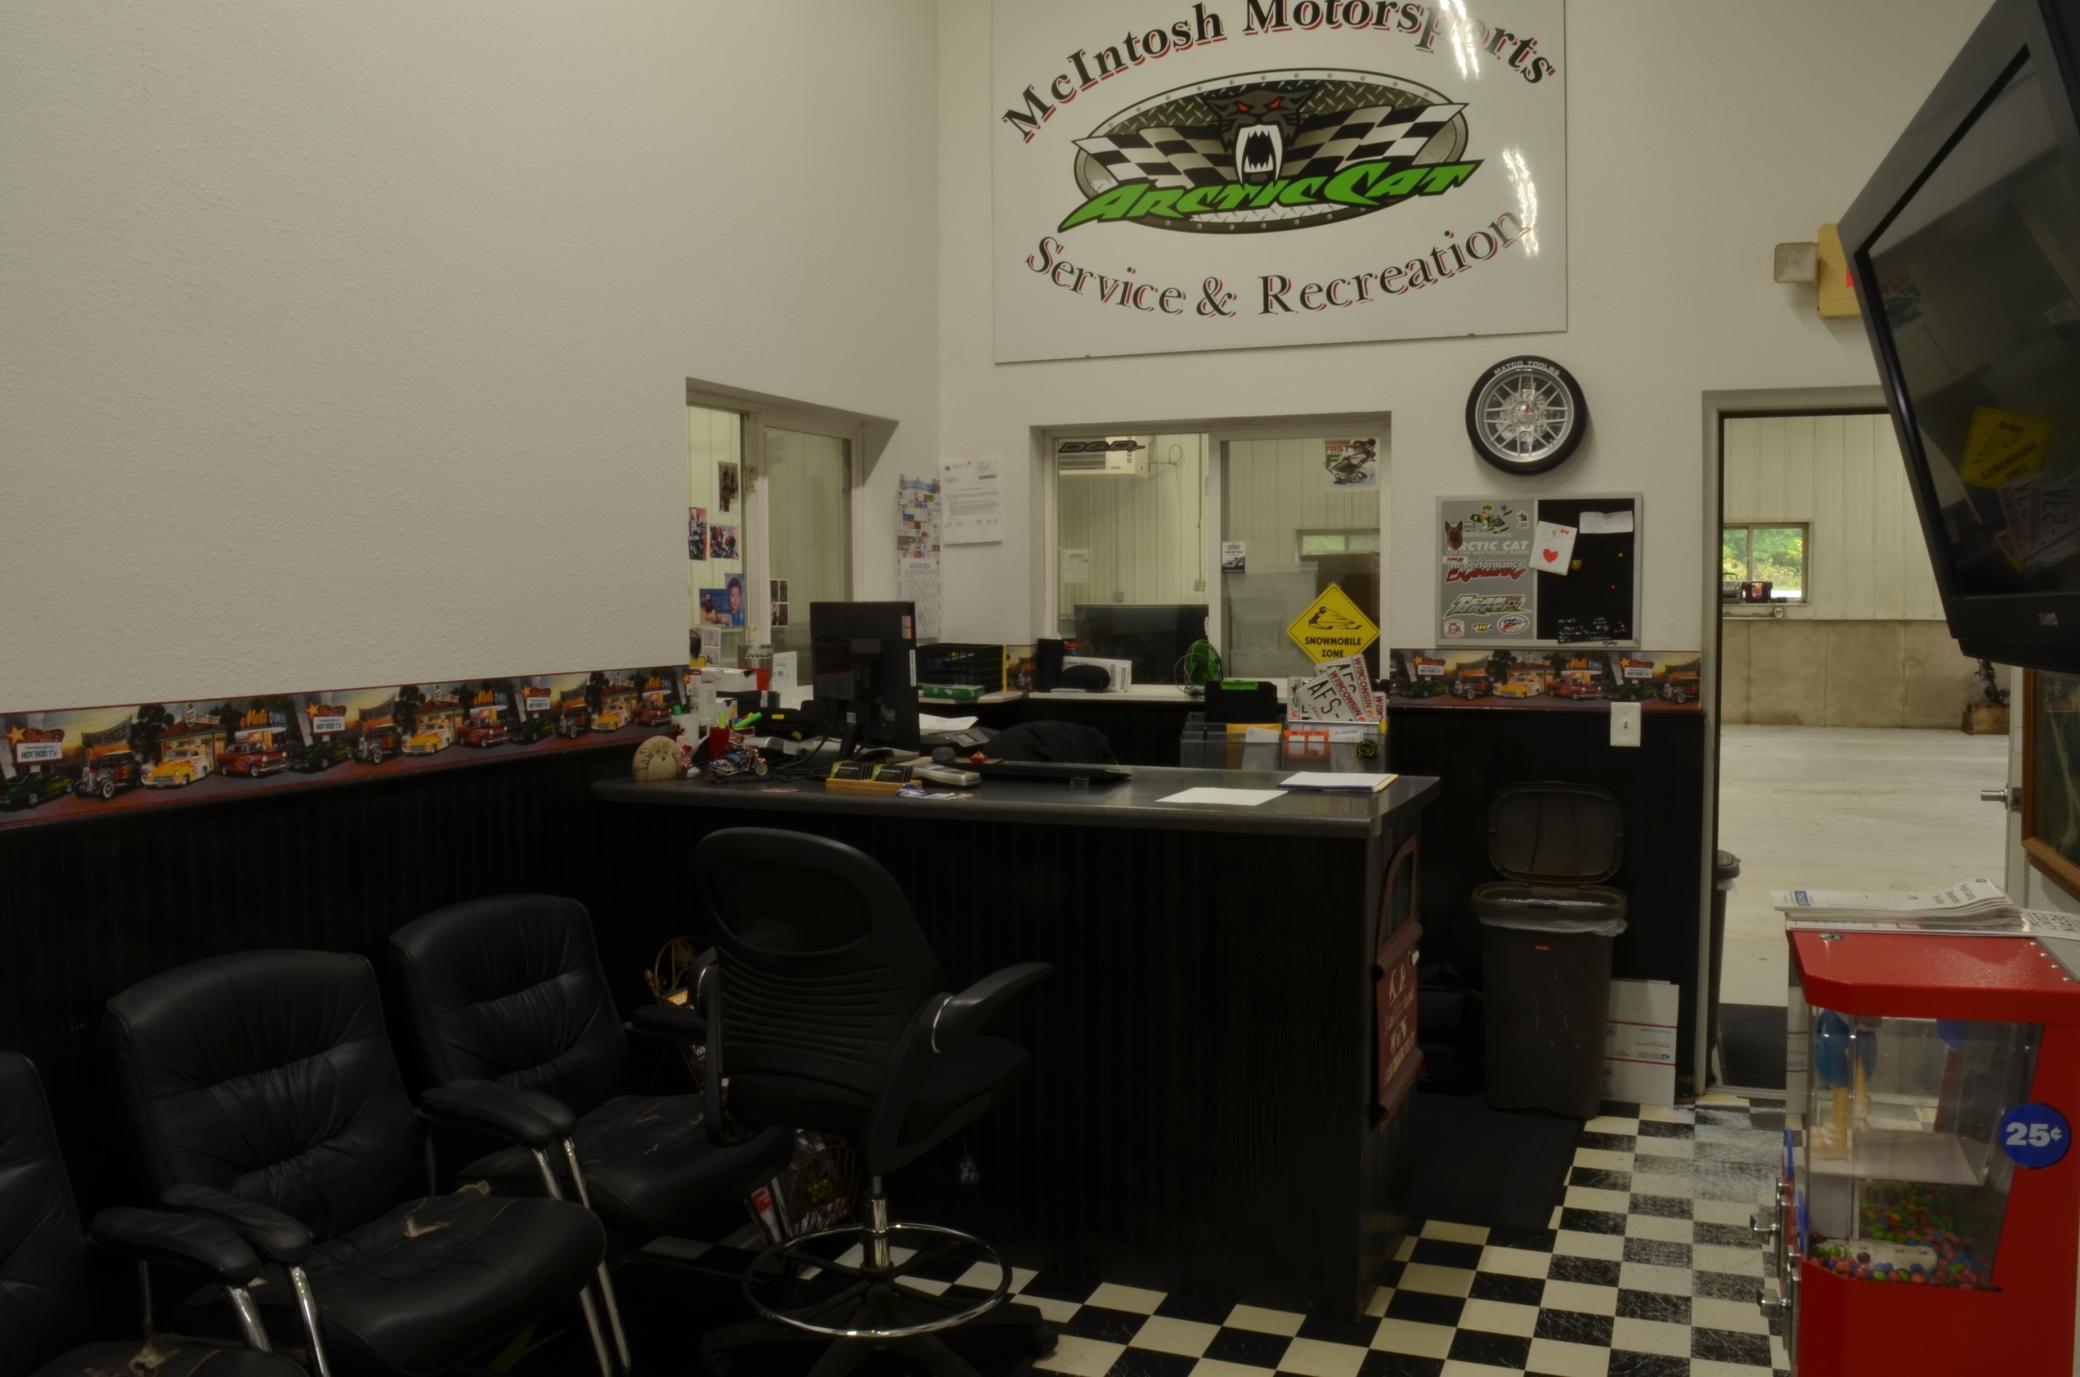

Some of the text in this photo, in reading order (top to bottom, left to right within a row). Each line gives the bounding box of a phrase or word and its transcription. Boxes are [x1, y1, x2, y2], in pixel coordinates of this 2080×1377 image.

[1001, 0, 1556, 144] McIntosh Motorsports
[1026, 210, 1531, 317] Service & Recreation
[1494, 361, 1523, 375] MATCO
[1447, 541, 1528, 551] RCTIC CAT
[1305, 637, 1361, 647] SNOWMOBILE
[1321, 649, 1344, 658] ZONE
[1354, 656, 1373, 708] WISCONSIN
[1331, 671, 1361, 717] WISCONSIN
[21, 750, 34, 759] HOT
[2006, 1122, 2063, 1147] 25¢
